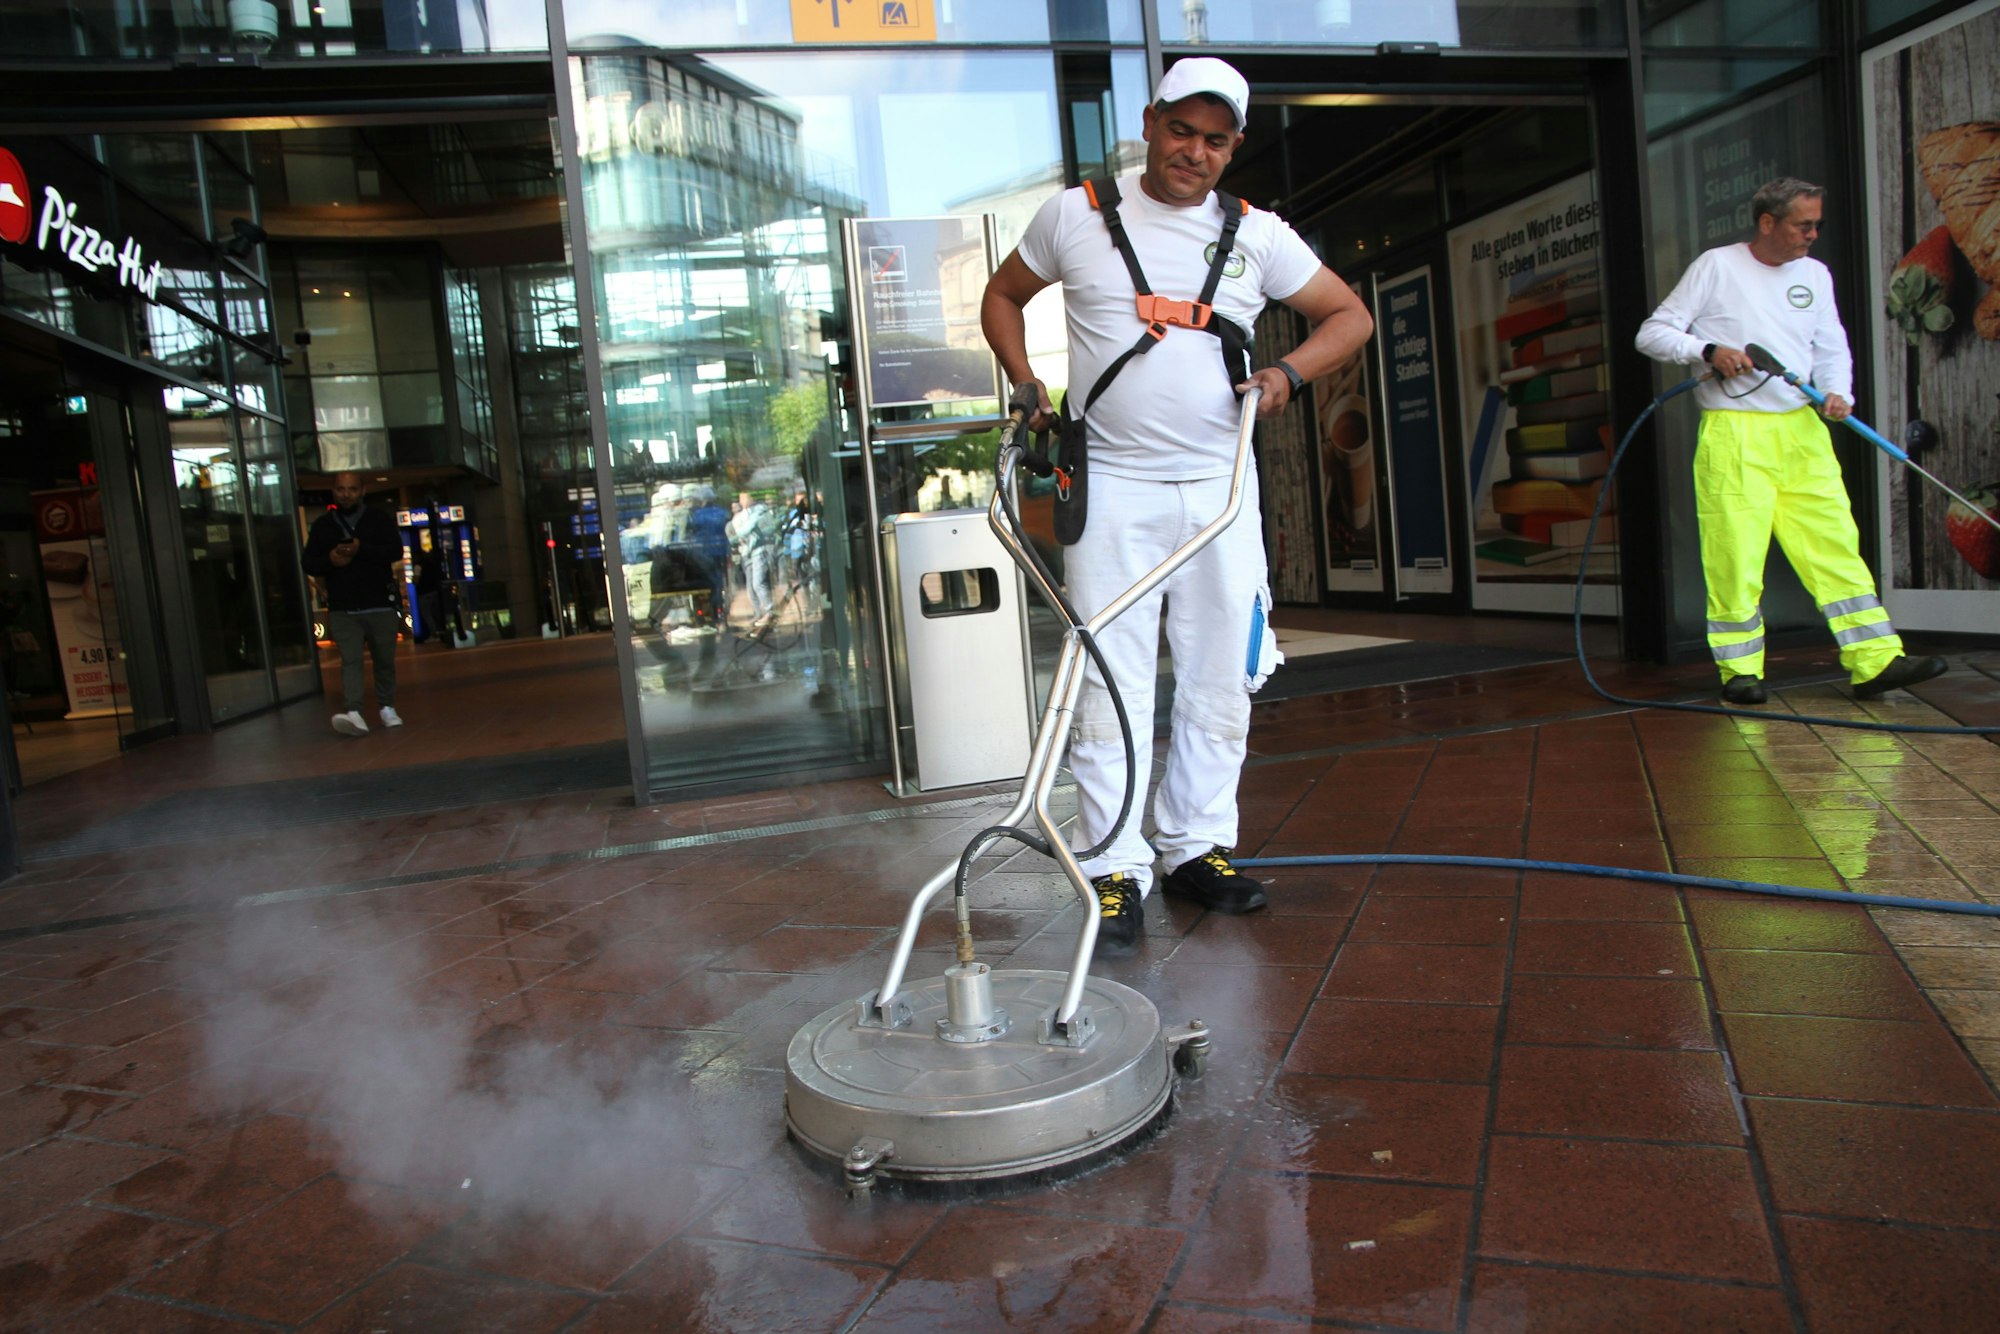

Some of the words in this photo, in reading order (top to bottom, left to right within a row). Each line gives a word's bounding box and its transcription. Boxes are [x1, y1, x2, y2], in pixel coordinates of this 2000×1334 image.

[1703, 138, 1750, 172] Wenn
[1705, 177, 1730, 206] Sie
[1471, 240, 1491, 263] Alle
[1493, 228, 1525, 260] guten
[1526, 214, 1563, 241] Worte
[1707, 214, 1732, 239] am
[38, 186, 117, 272] Pizza
[118, 236, 163, 300] Hut
[1498, 253, 1535, 280] stehen
[1537, 247, 1549, 266] in
[1392, 316, 1407, 336] die
[1394, 334, 1427, 359] richtige
[81, 647, 104, 664] 4.90
